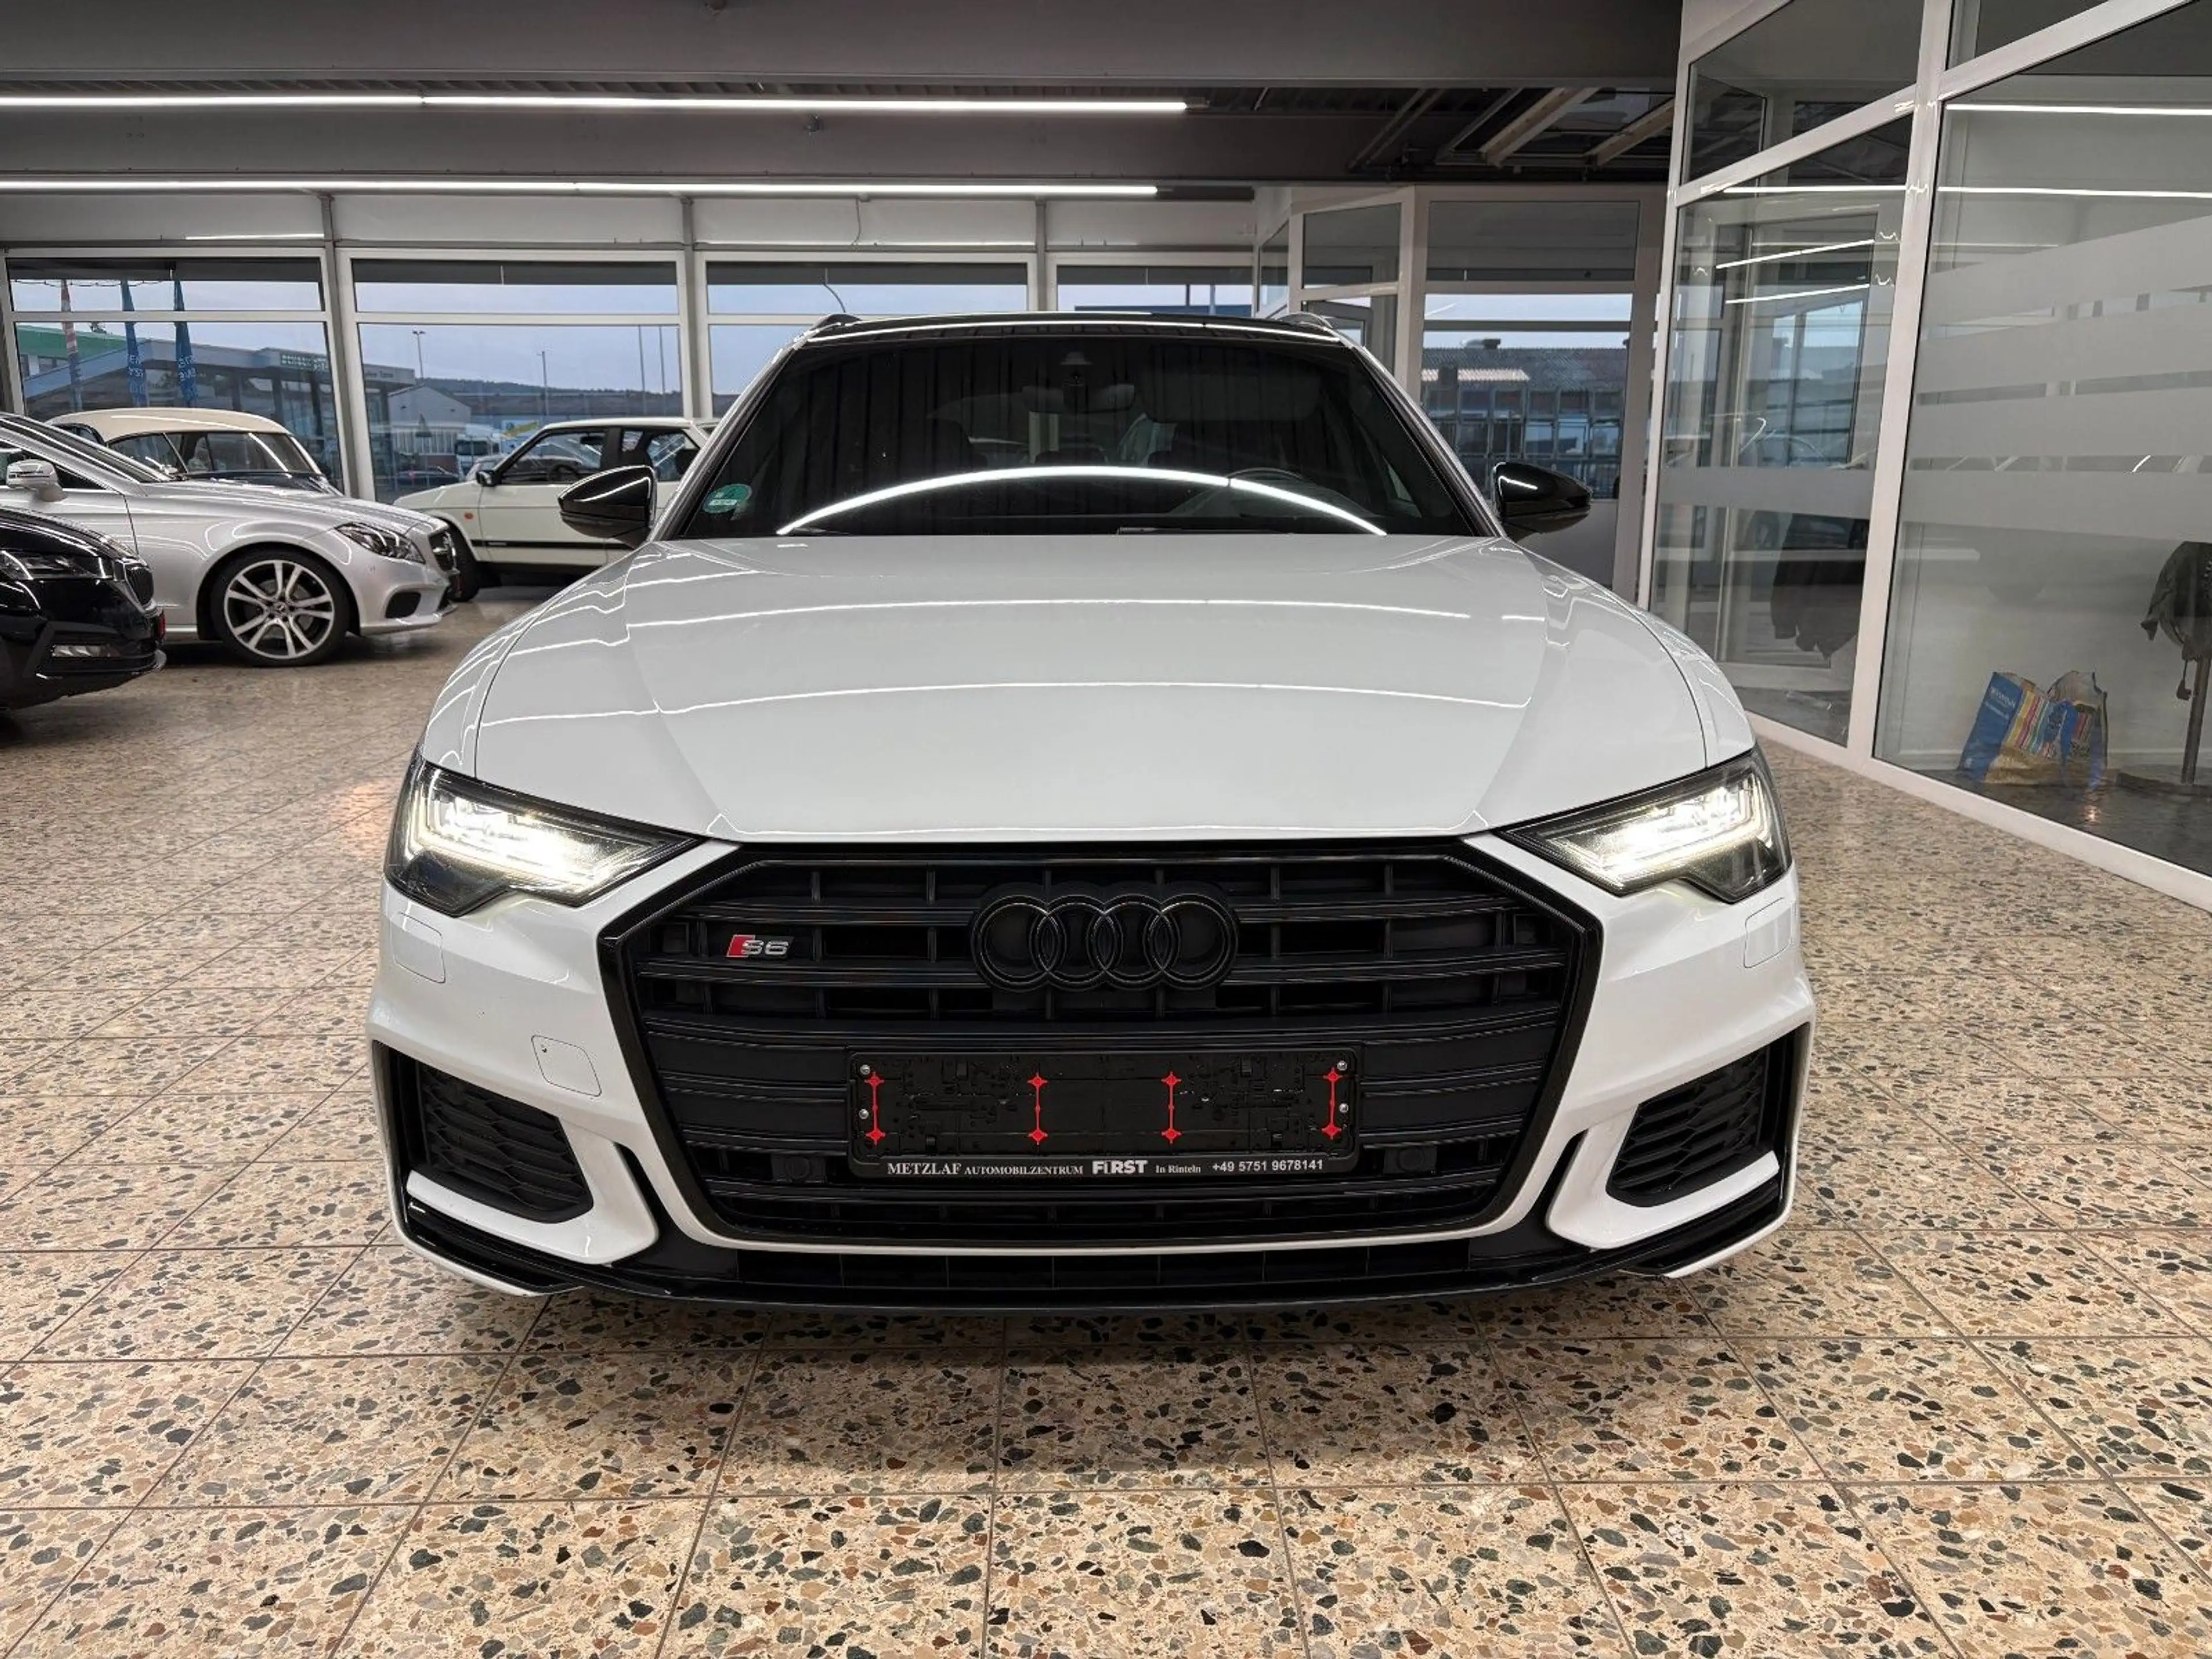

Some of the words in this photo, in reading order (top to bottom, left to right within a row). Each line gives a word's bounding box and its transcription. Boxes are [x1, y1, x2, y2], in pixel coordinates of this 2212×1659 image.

[741, 940, 789, 955] S6
[887, 1162, 961, 1175] METZLAF
[964, 1165, 1084, 1175] AUTOMOBILZENTRUM
[1168, 1164, 1201, 1173] Rinteln
[1213, 1161, 1234, 1172] +49
[1238, 1161, 1267, 1171] 5751
[1271, 1159, 1323, 1171] 9678141
